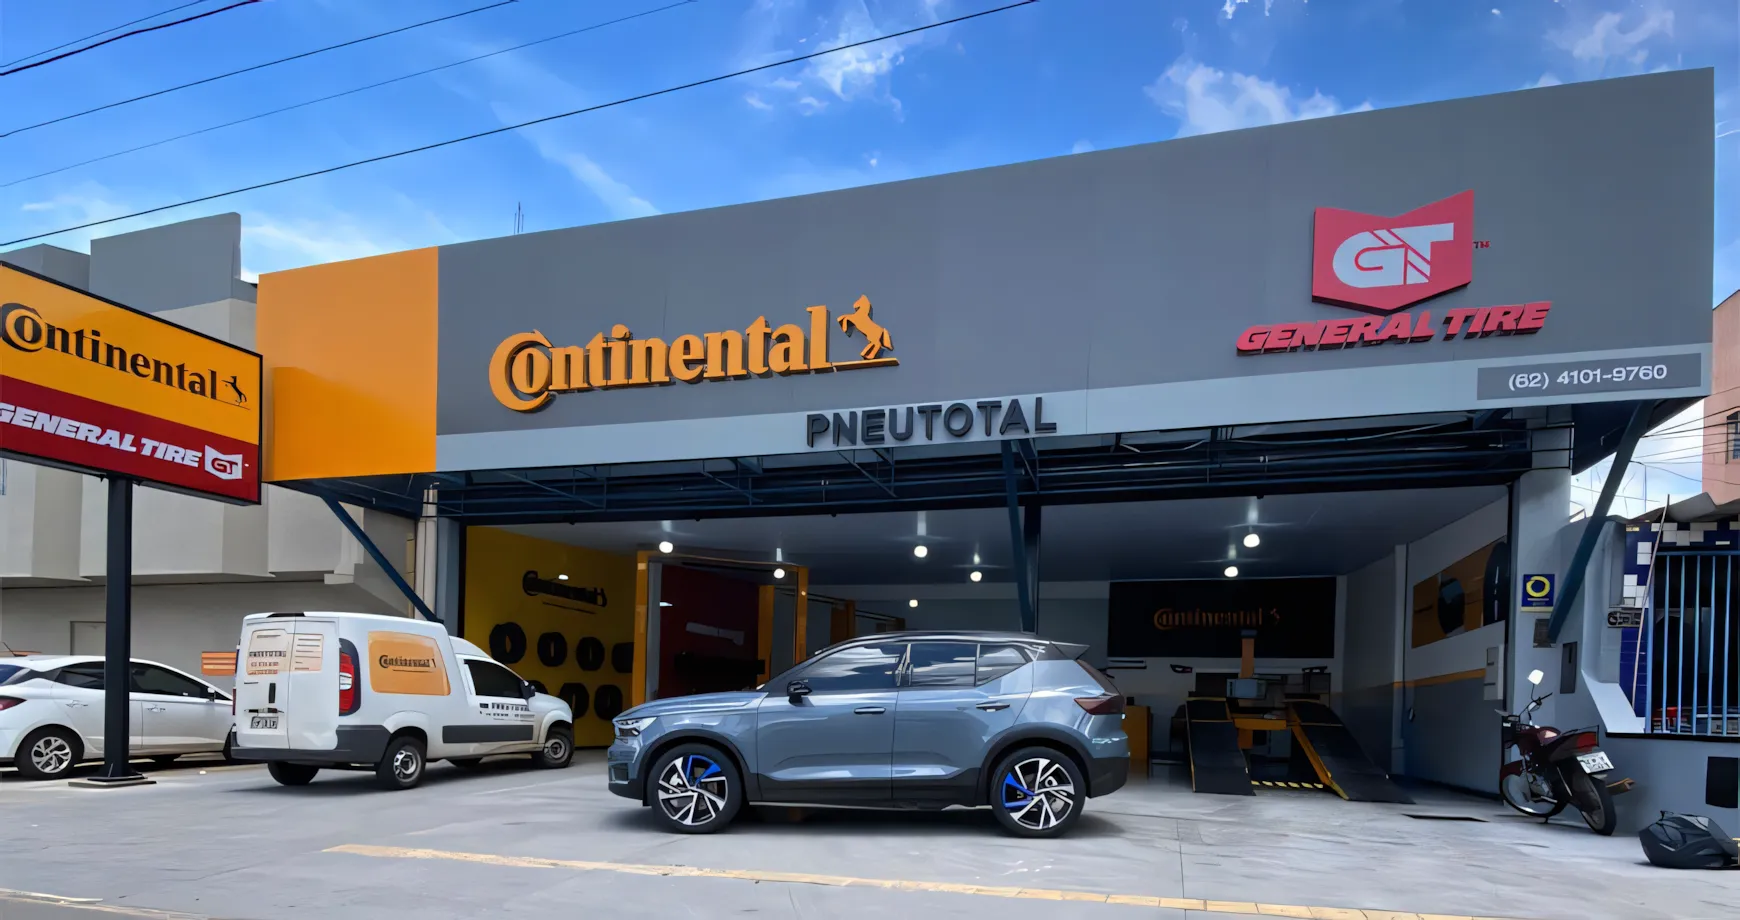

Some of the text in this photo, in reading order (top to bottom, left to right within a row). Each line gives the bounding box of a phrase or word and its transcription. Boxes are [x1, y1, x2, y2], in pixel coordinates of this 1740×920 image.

[1332, 222, 1454, 288] GT
[0, 302, 217, 401] Continental
[488, 304, 830, 413] Continental
[1236, 301, 1552, 356] GENERAL TIRE
[1508, 364, 1668, 391] (62) 4101-9760
[0, 402, 203, 468] GENERAL TIRE
[806, 396, 1057, 448] PNEUTOTAL
[211, 457, 239, 475] GT
